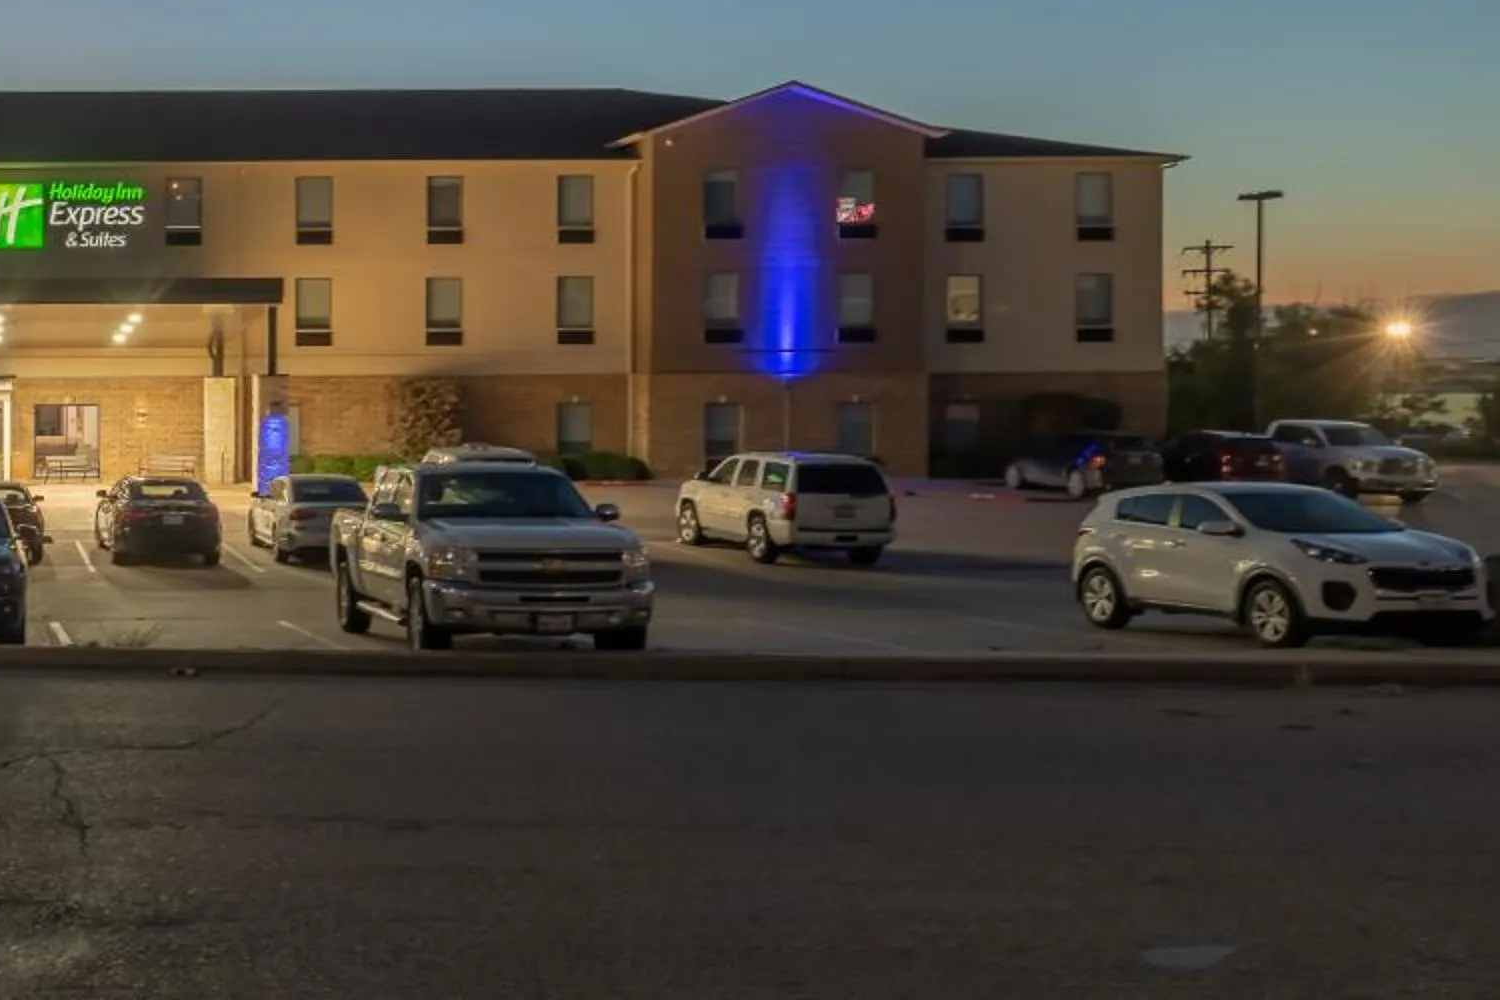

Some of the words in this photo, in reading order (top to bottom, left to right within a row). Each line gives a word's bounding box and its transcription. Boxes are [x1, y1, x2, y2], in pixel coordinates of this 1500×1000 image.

[50, 182, 114, 204] Holiday
[115, 182, 144, 200] Inn
[49, 201, 145, 231] Express
[65, 232, 78, 248] &
[79, 232, 127, 248] Suites
